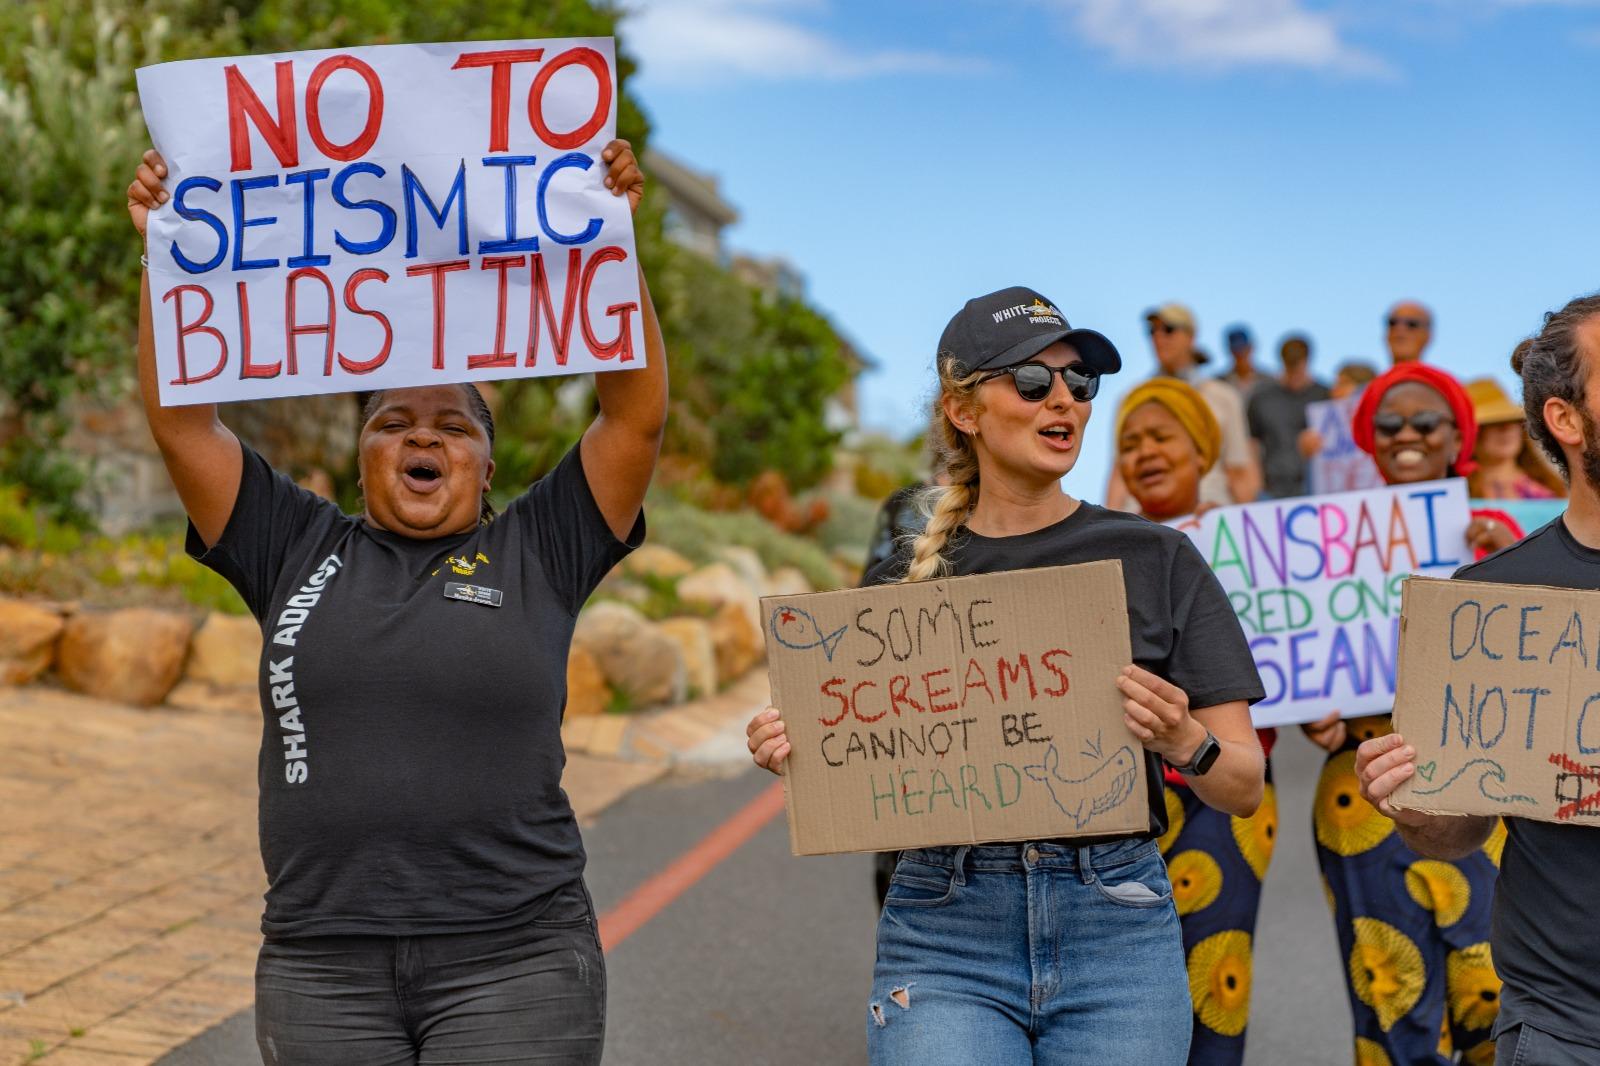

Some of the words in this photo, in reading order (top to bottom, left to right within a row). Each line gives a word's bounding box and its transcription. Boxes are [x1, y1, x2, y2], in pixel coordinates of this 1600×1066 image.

[224, 54, 385, 172] NO
[451, 46, 612, 152] TO
[170, 152, 604, 274] SEISMIC
[162, 246, 638, 386] BLASTING
[992, 304, 1030, 323] WHITE
[1028, 315, 1062, 326] PROJECTS
[1176, 491, 1460, 589] ANSBAAI
[856, 600, 1000, 667] SOME
[1450, 600, 1600, 671] OCEA
[269, 655, 309, 785] SHARK
[818, 648, 1073, 727] SCREAMS
[1440, 683, 1552, 750] NOT
[820, 717, 978, 767] CANNOT
[1001, 712, 1054, 748] BE
[871, 763, 1022, 822] HEARD
